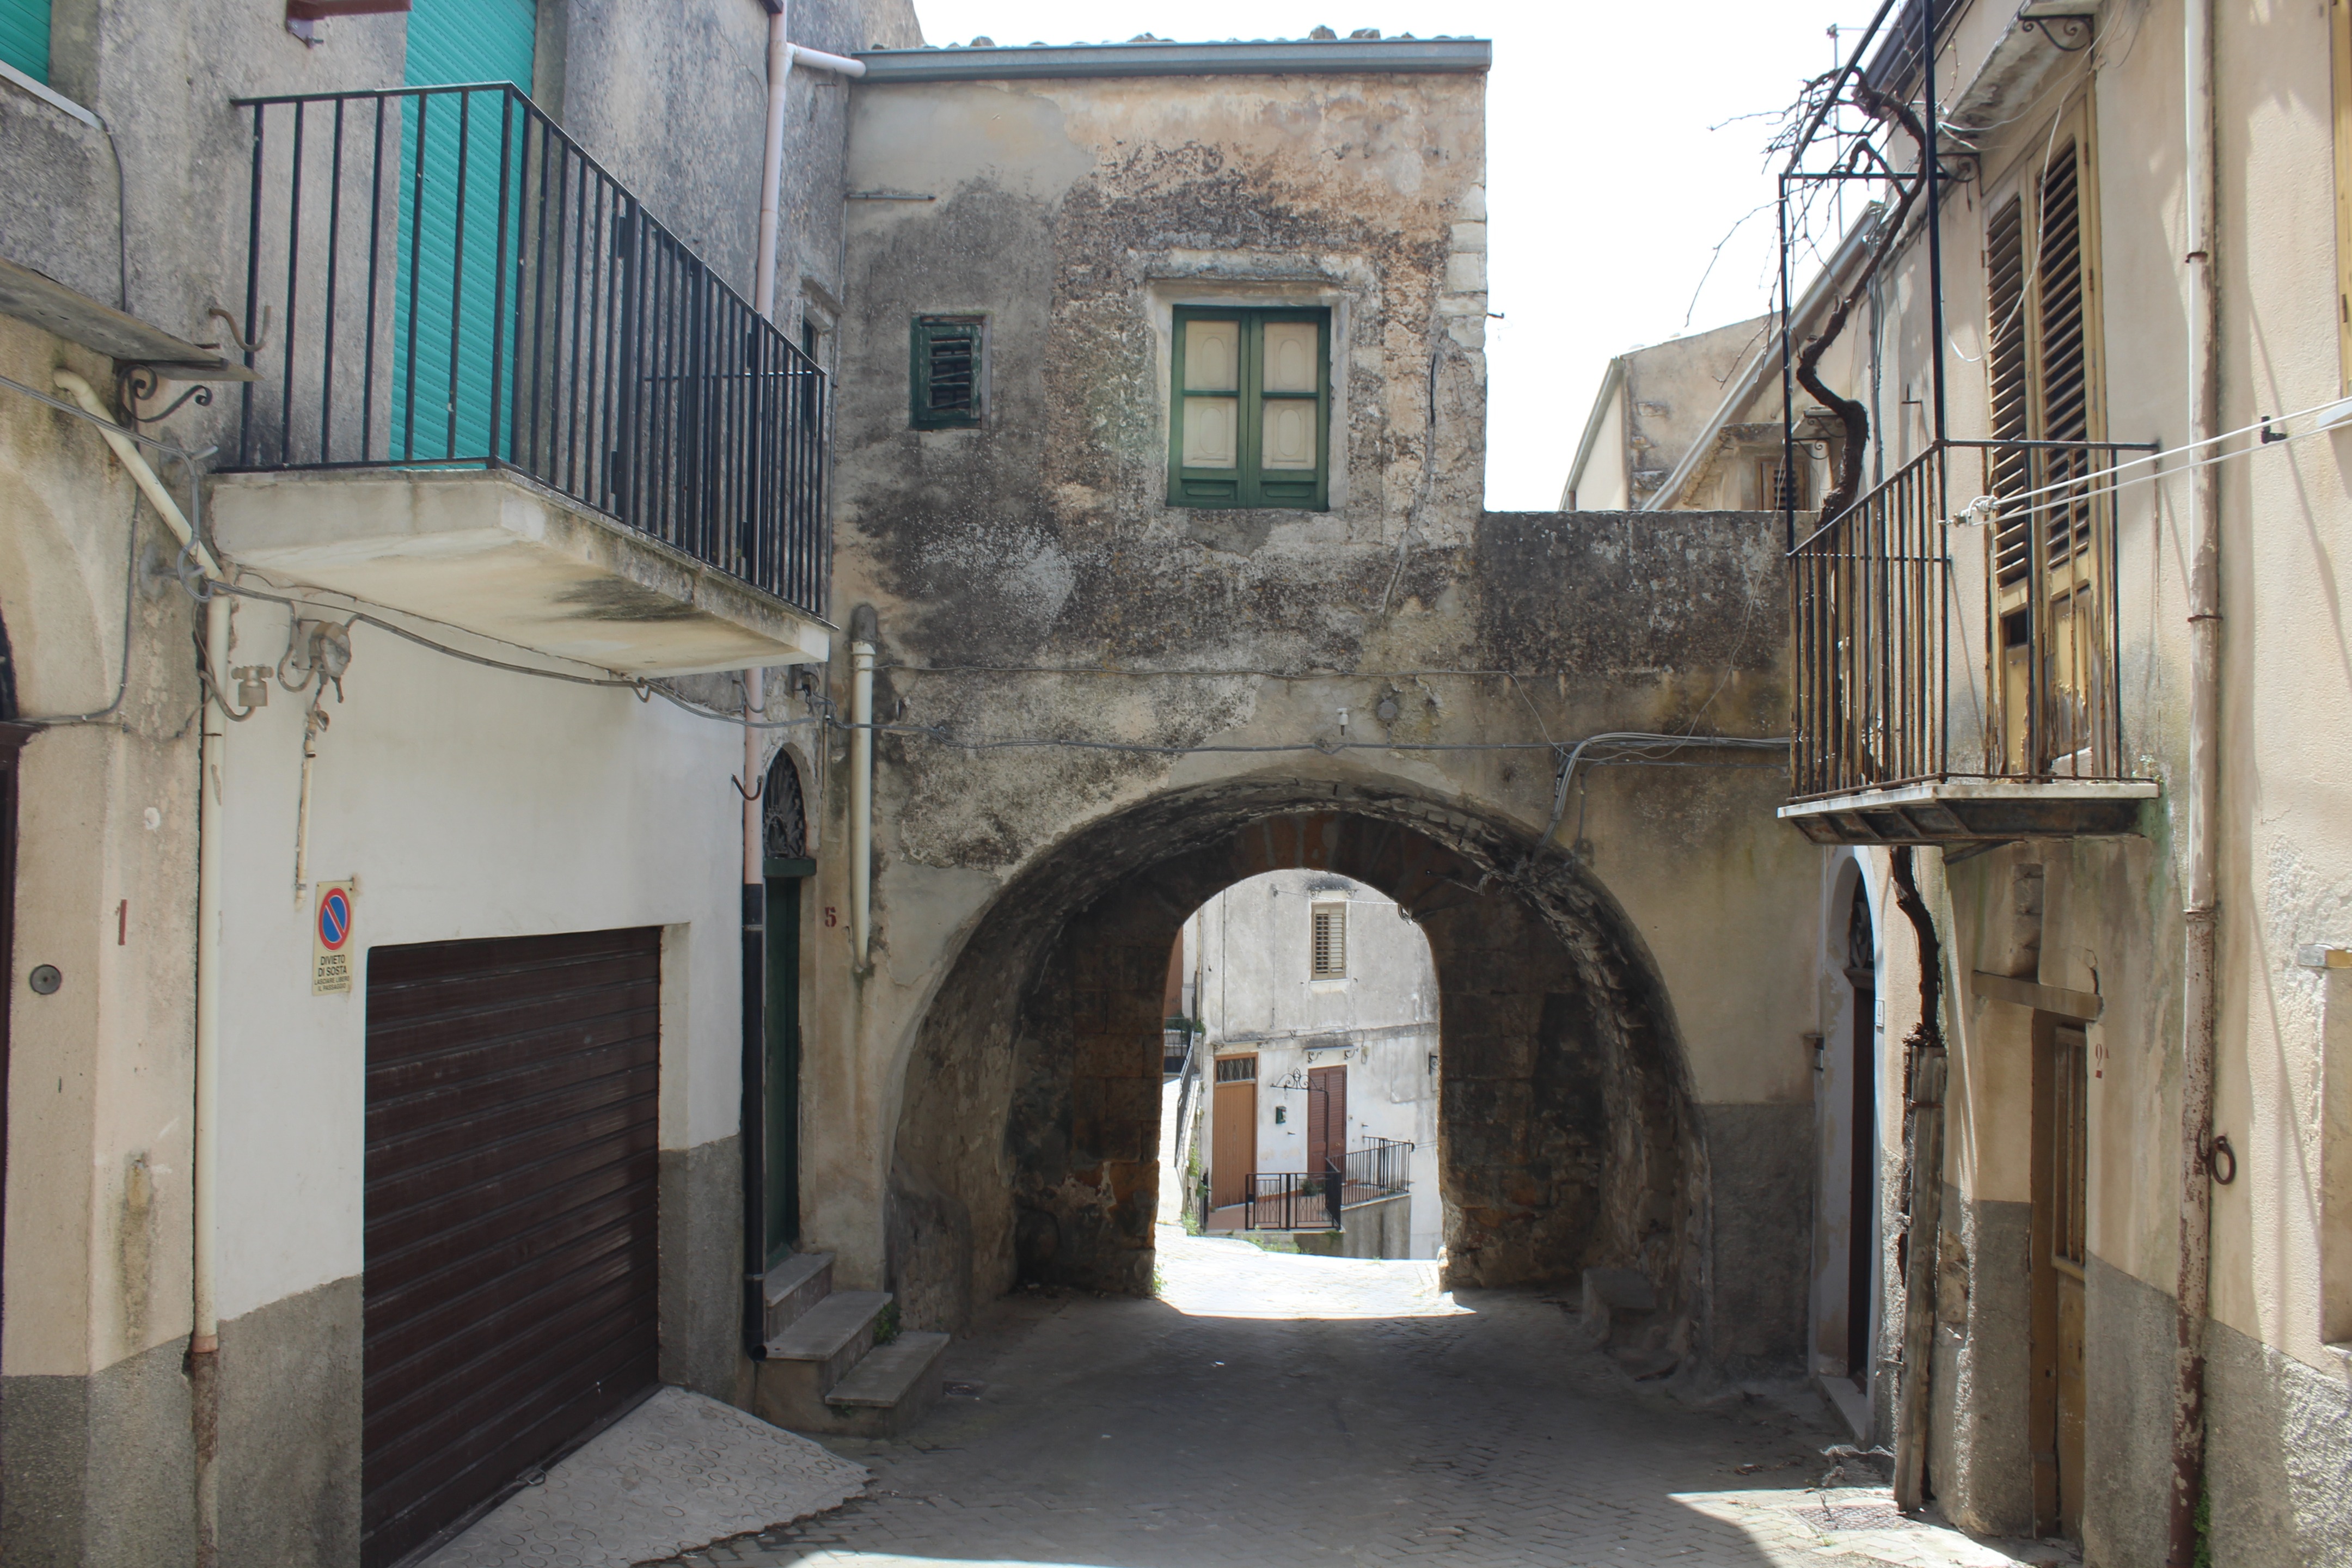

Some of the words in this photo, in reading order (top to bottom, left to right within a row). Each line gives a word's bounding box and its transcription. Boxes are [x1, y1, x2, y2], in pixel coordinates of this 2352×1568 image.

[824, 906, 836, 927] 5
[321, 954, 345, 965] DIVIETO
[318, 967, 325, 977] DI
[327, 966, 347, 976] SOSTA
[323, 982, 346, 990] PASSAGGIO
